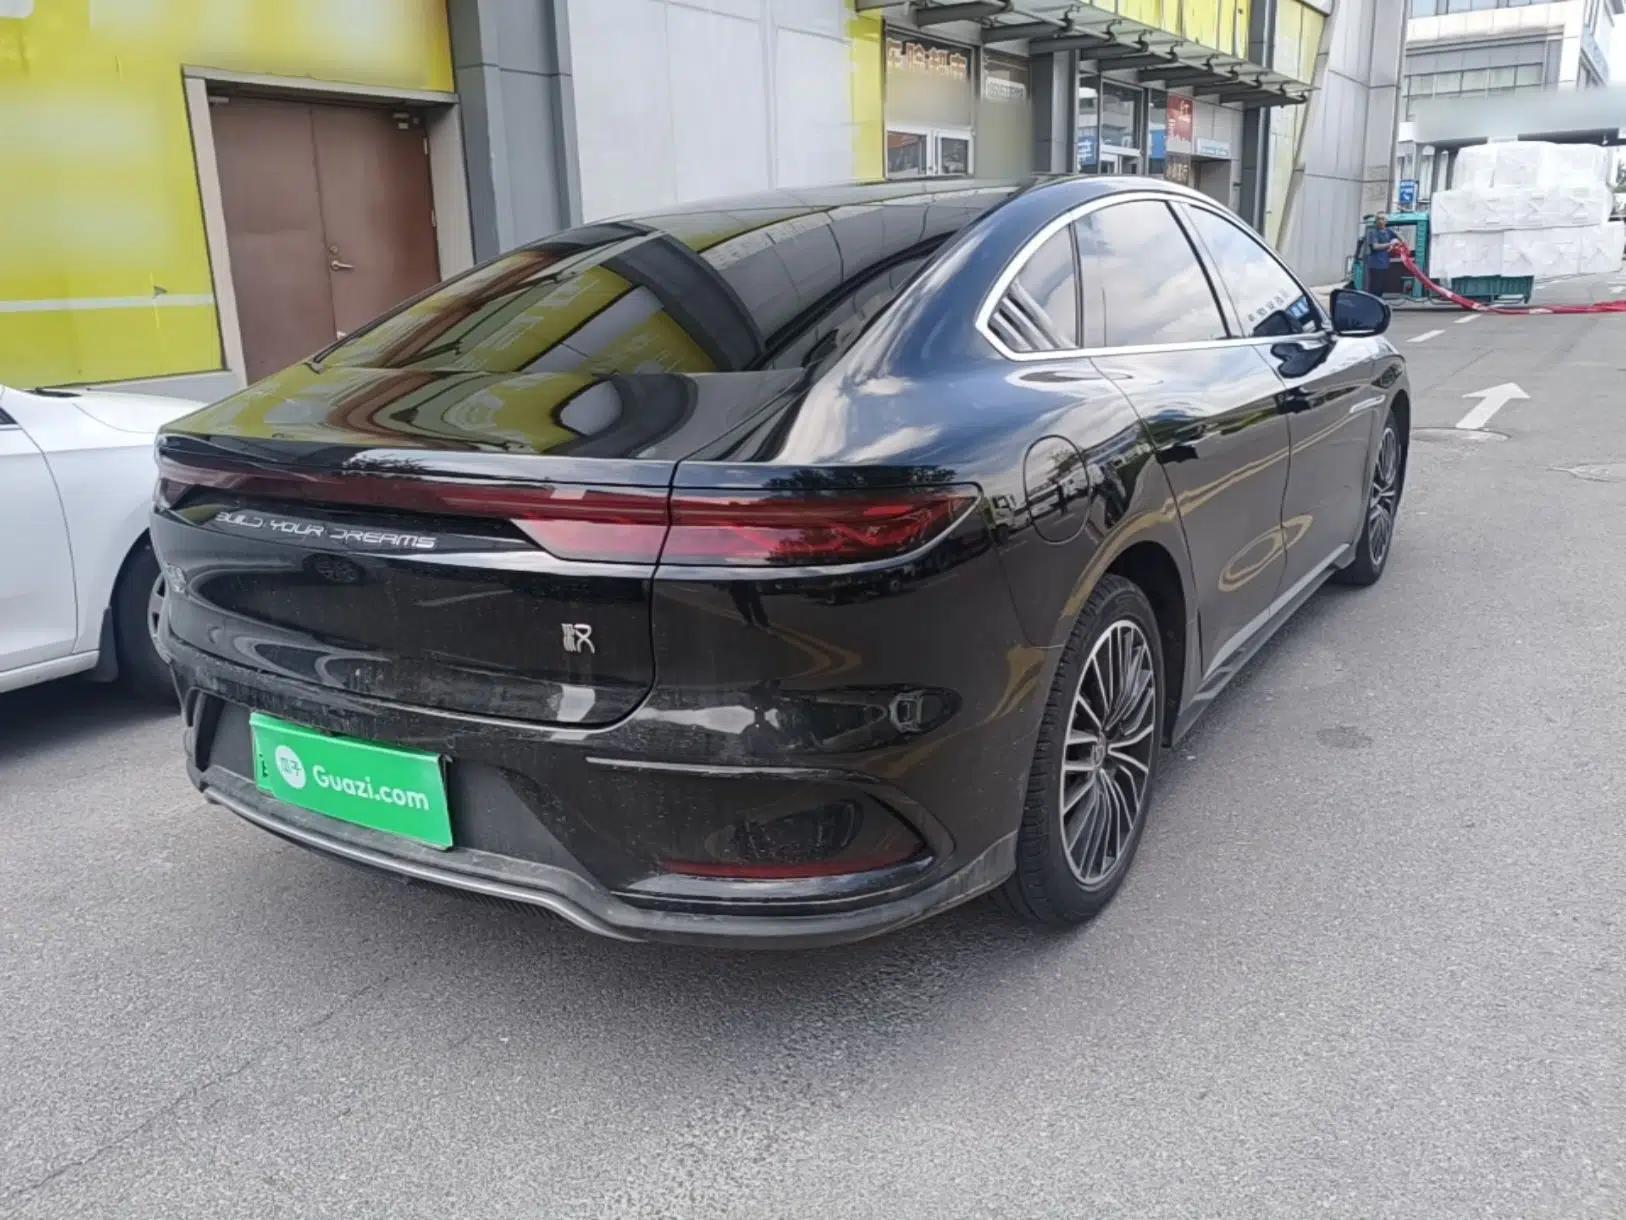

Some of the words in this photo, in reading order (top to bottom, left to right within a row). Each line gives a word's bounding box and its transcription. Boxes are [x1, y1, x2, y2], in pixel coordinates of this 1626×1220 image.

[214, 511, 263, 528] BUILD
[269, 519, 325, 537] YOUR
[329, 528, 437, 549] DREAMS
